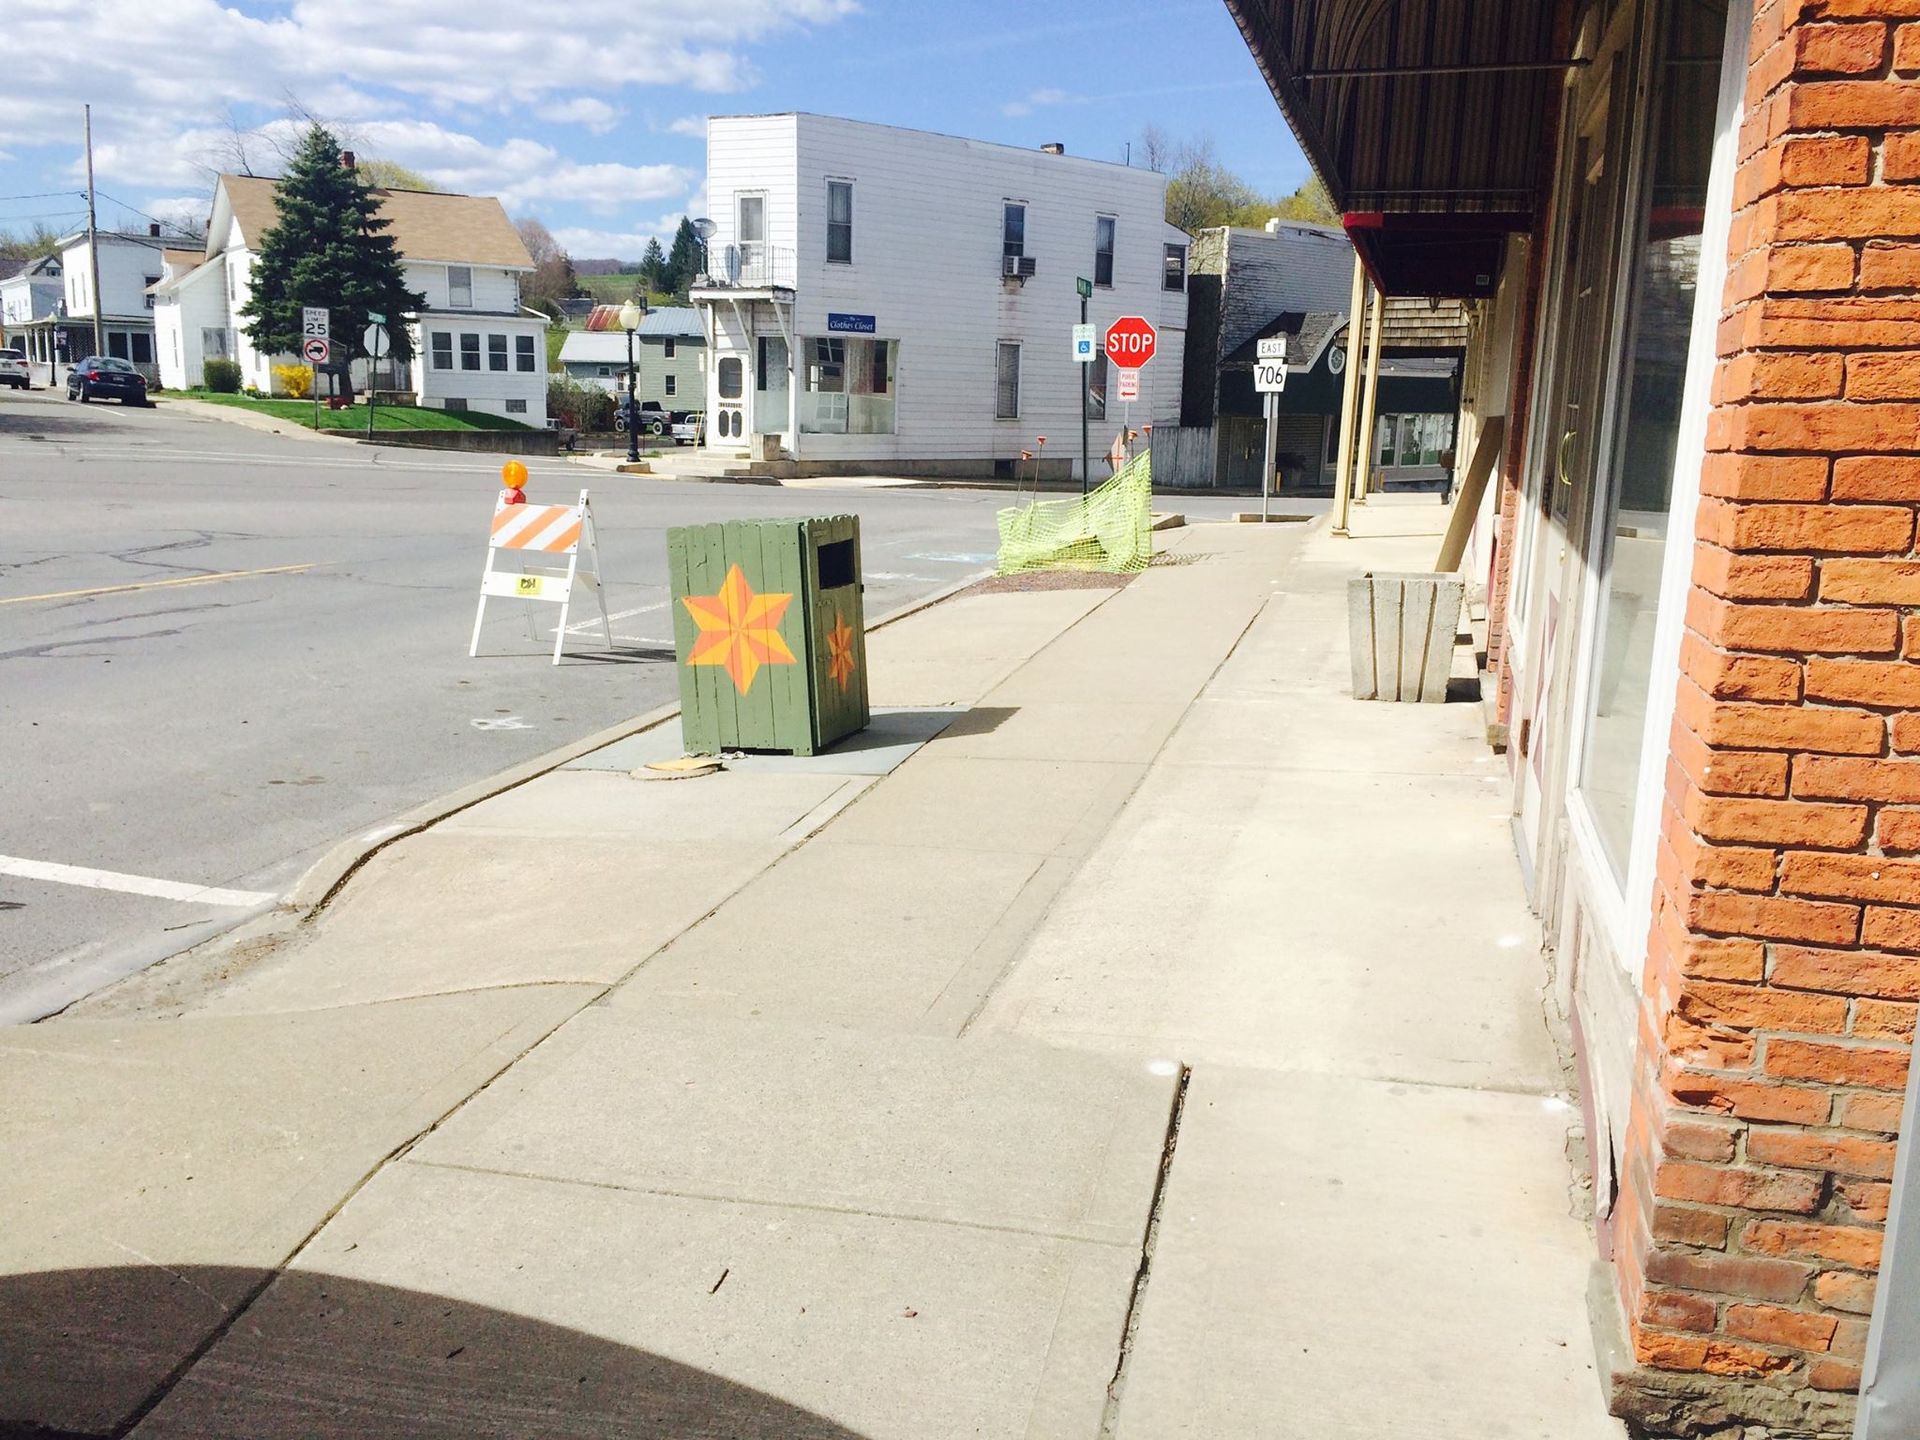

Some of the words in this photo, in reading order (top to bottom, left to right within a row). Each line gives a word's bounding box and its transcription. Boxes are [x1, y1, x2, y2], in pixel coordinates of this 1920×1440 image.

[305, 309, 327, 317] SPEED
[305, 322, 326, 335] 25
[1109, 333, 1152, 353] STOP
[1261, 342, 1282, 354] EAST
[1257, 366, 1283, 384] 706
